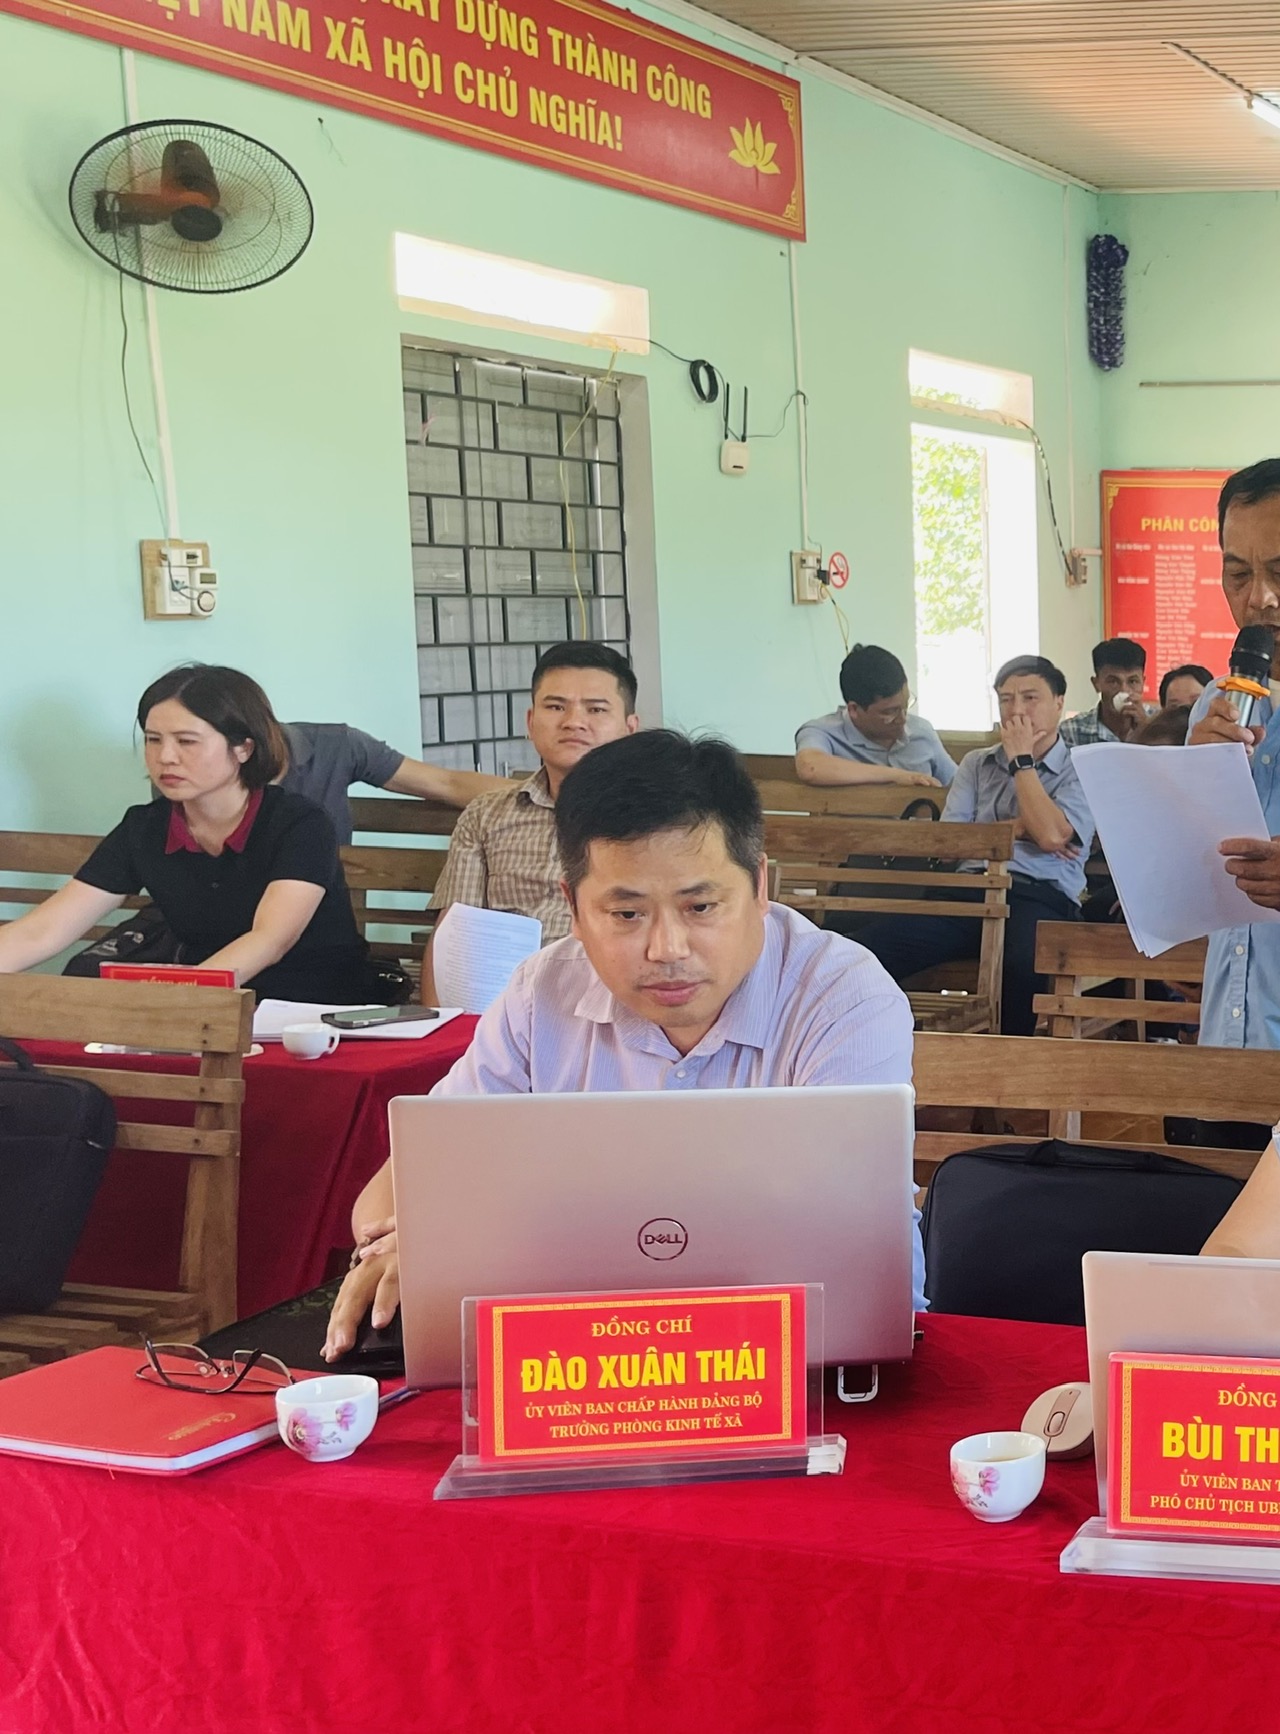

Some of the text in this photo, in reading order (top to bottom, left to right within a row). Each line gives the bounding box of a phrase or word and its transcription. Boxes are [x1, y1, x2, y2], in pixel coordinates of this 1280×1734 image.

[323, 16, 373, 72] XÃ
[383, 37, 443, 99] HỘI
[453, 61, 518, 119] CHỦ
[529, 86, 623, 152] NGHĨA!
[547, 26, 638, 94] THÀNH
[646, 63, 712, 120] CÔNG
[1141, 516, 1185, 532] PHÂN
[1188, 516, 1219, 533] CÔN
[644, 1233, 683, 1245] DELL
[591, 1314, 692, 1337] ĐỒNG CHÍ
[520, 1341, 766, 1393] ĐÀO XUÂN THÁI
[525, 1390, 763, 1418] ỦY VIÊN BAN CHẤP HÀNH ĐẢNG BỘ
[1218, 1382, 1277, 1408] ĐỒNG
[549, 1412, 743, 1438] TRƯỞNG PHÒNG KINH TẾ XÃ
[1162, 1415, 1223, 1461] BÙI
[1180, 1468, 1199, 1488] ỦY
[1203, 1472, 1238, 1490] VIÊN
[1241, 1478, 1272, 1491] BAN
[1150, 1493, 1181, 1509] PHÓ
[1185, 1493, 1216, 1511] CHỦ
[1219, 1499, 1255, 1515] TỊCH
